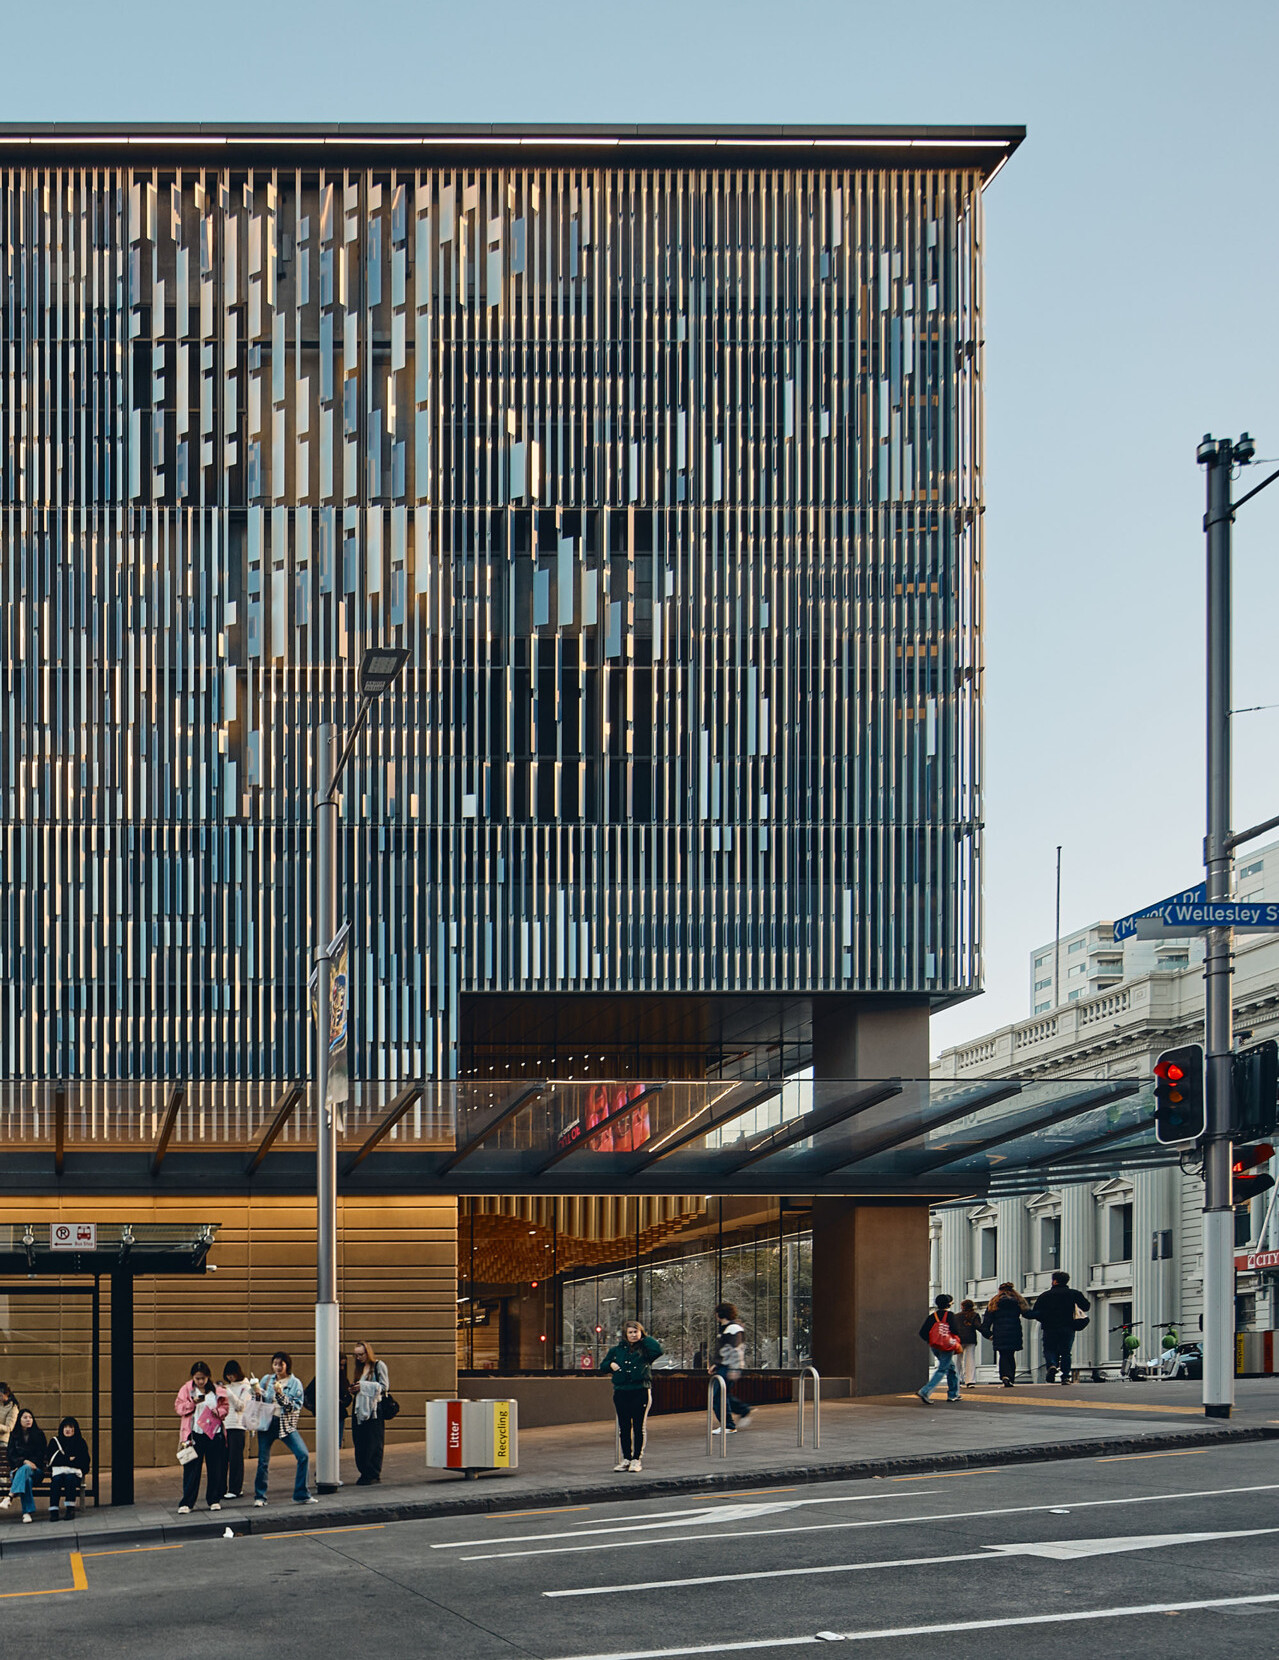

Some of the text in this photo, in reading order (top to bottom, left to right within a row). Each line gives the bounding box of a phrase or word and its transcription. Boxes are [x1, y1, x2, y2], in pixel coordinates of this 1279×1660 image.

[1183, 891, 1200, 903] Dr
[1176, 905, 1260, 924] Wellesley
[1266, 905, 1279, 921] S
[1256, 1252, 1279, 1266] CITY
[449, 1421, 459, 1448] Litter
[497, 1411, 508, 1457] Recycling
